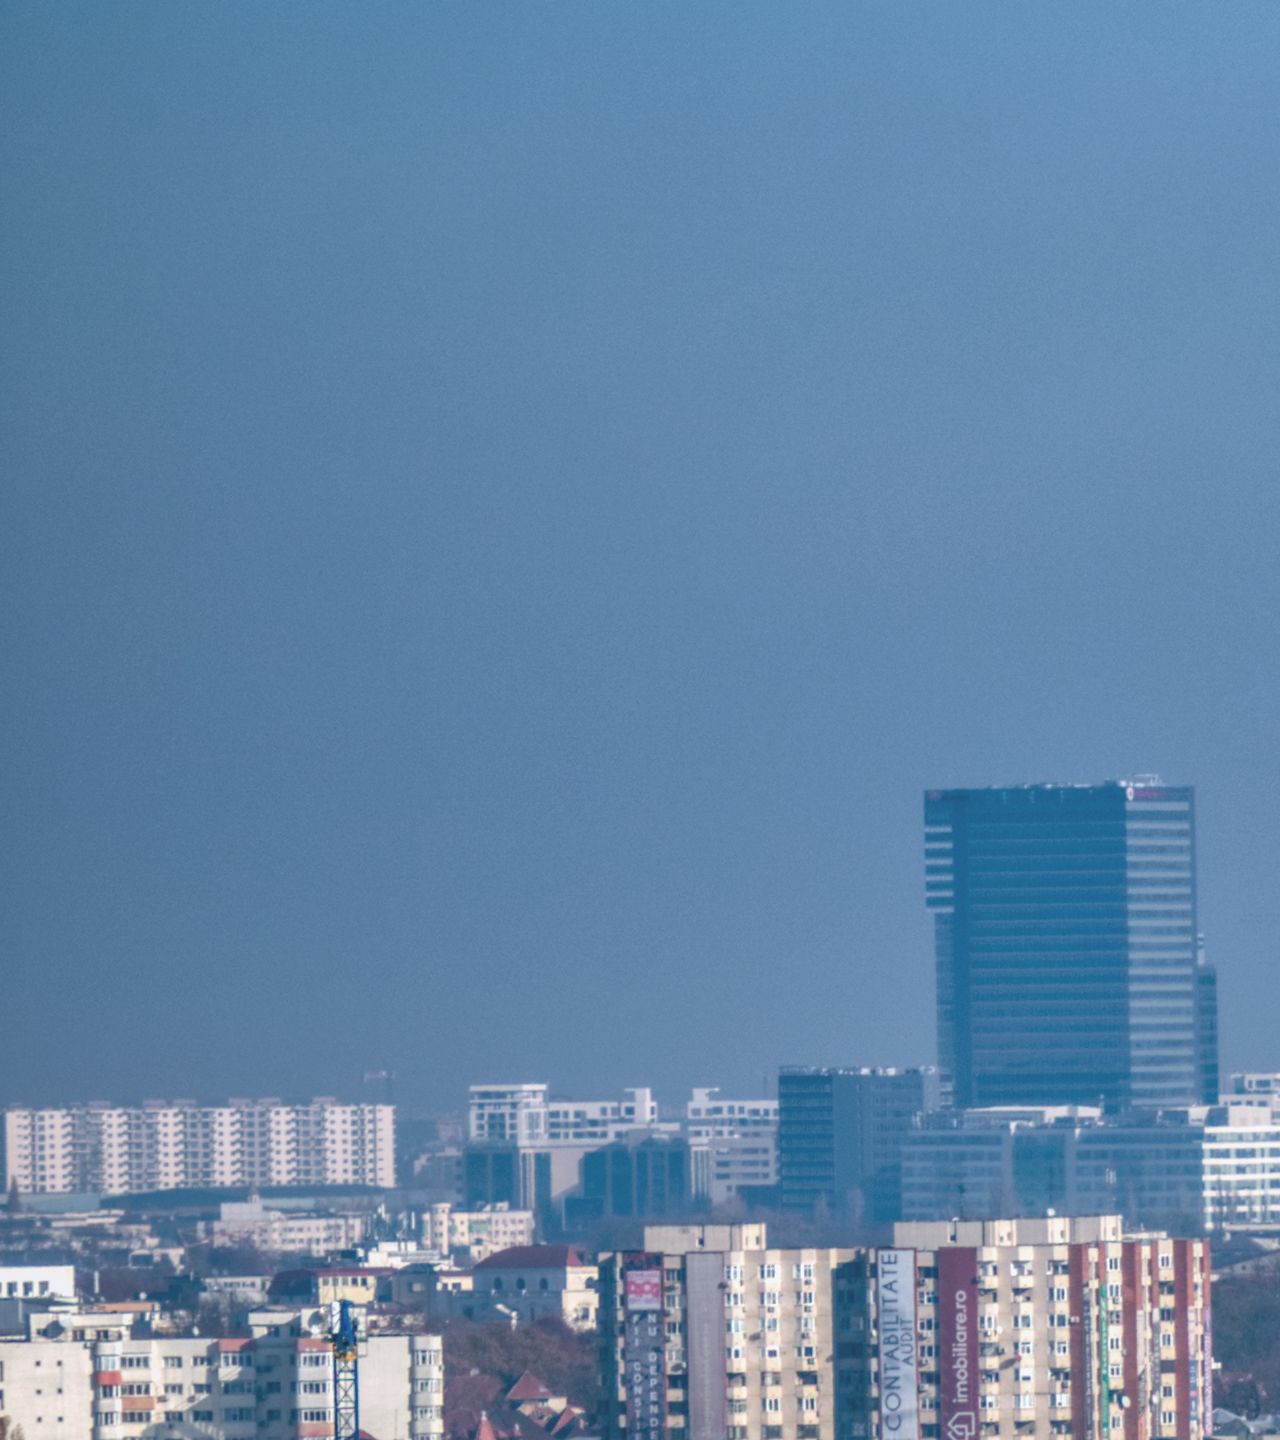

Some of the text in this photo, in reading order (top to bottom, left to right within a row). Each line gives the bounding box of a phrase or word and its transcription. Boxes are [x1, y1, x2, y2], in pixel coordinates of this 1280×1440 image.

[881, 1252, 901, 1432] CONTABILITATE
[902, 1318, 914, 1366] AUDIT
[952, 1289, 968, 1404] imobiliare.ro
